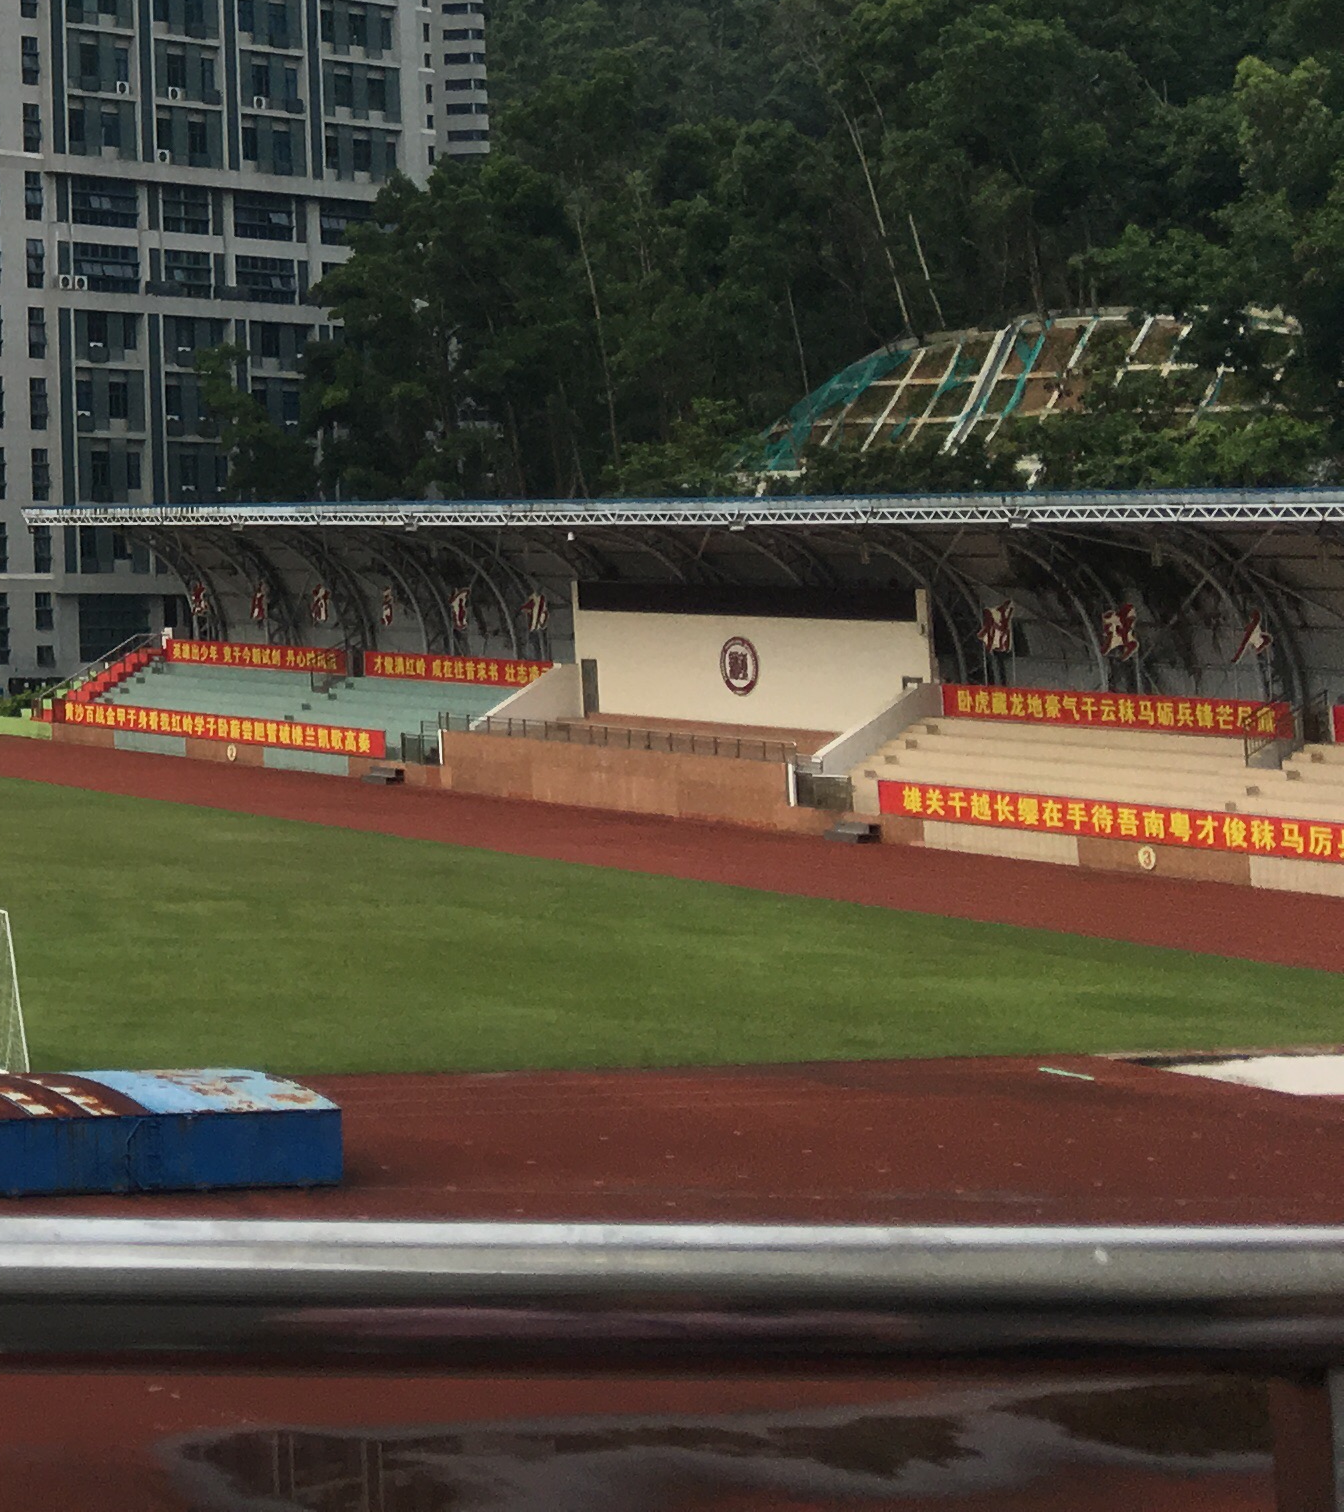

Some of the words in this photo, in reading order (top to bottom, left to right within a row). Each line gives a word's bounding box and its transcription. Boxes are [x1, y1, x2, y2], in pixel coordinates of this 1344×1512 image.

[902, 786, 1344, 858] 雄关千越长缨在手待吾南粤才俊秣马厉
